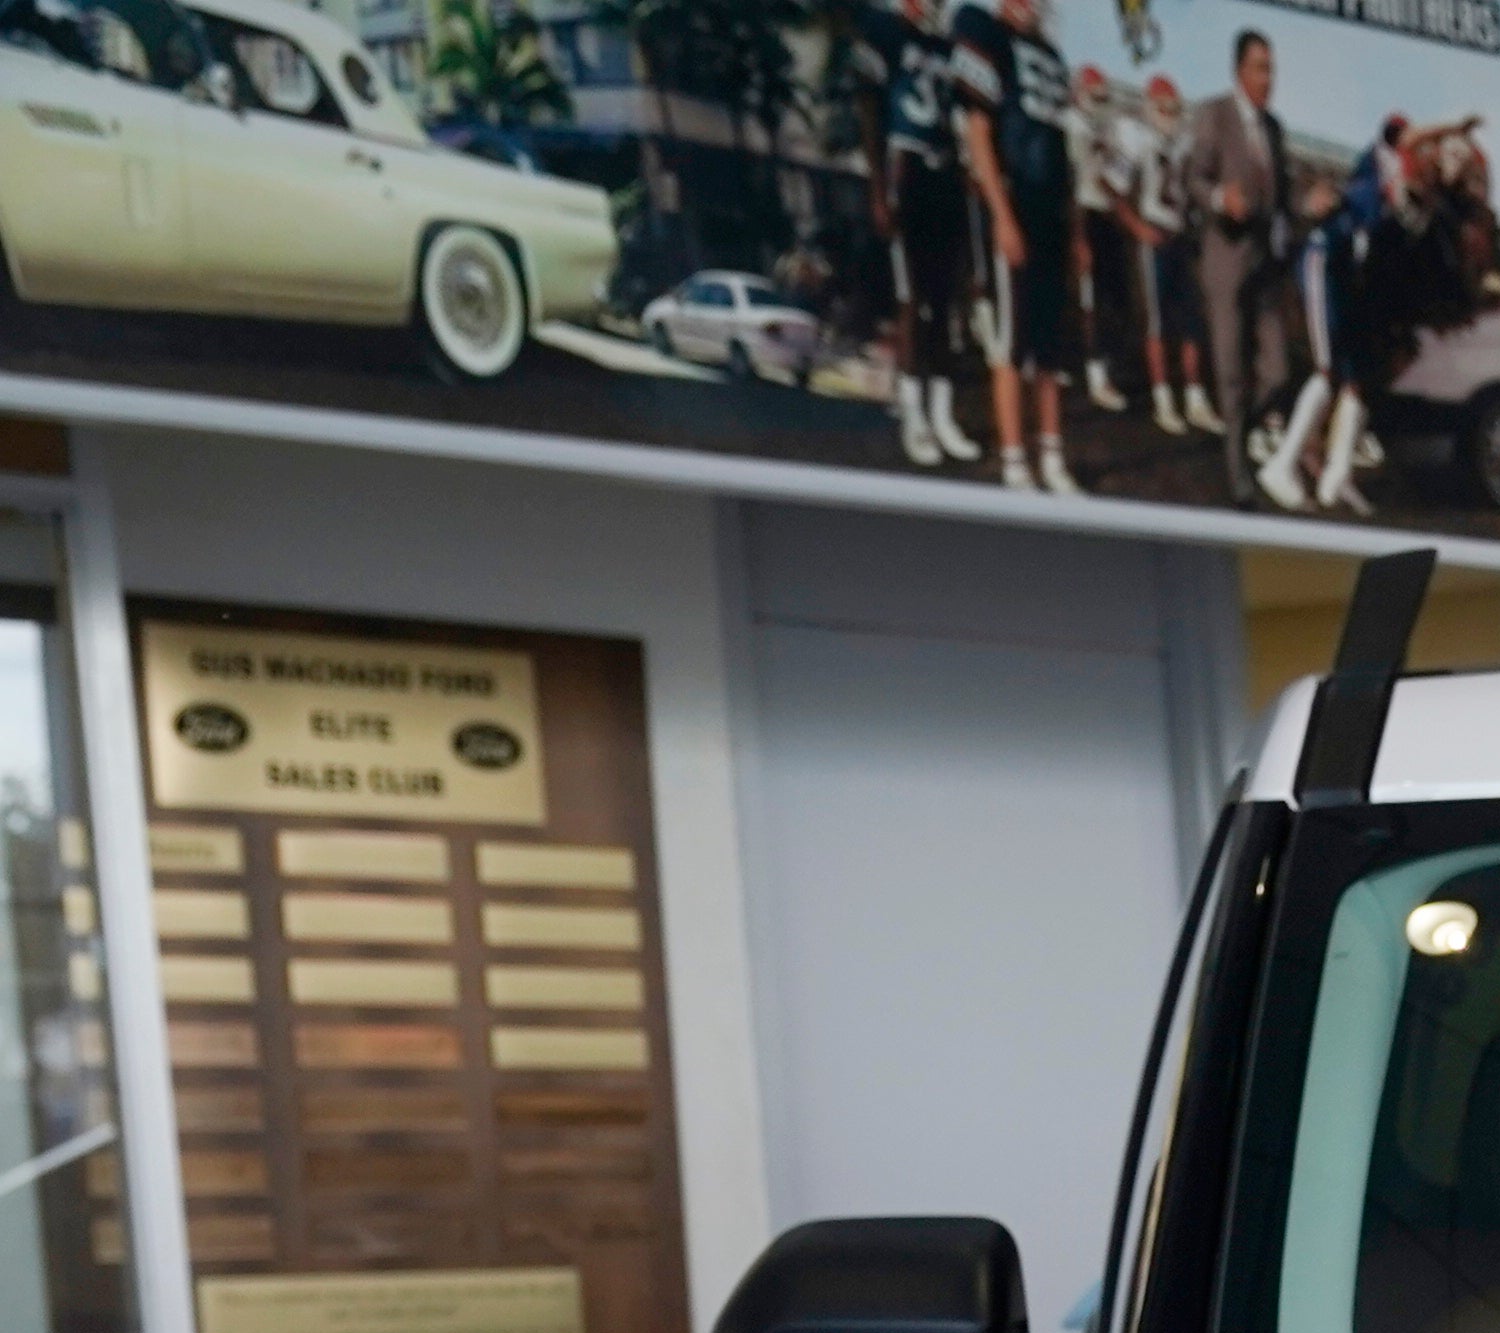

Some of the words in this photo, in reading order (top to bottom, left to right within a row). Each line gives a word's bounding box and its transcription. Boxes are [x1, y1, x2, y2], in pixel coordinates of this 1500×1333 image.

[191, 648, 253, 680] GUS
[308, 708, 393, 743] ELITE
[264, 758, 358, 794] SALES
